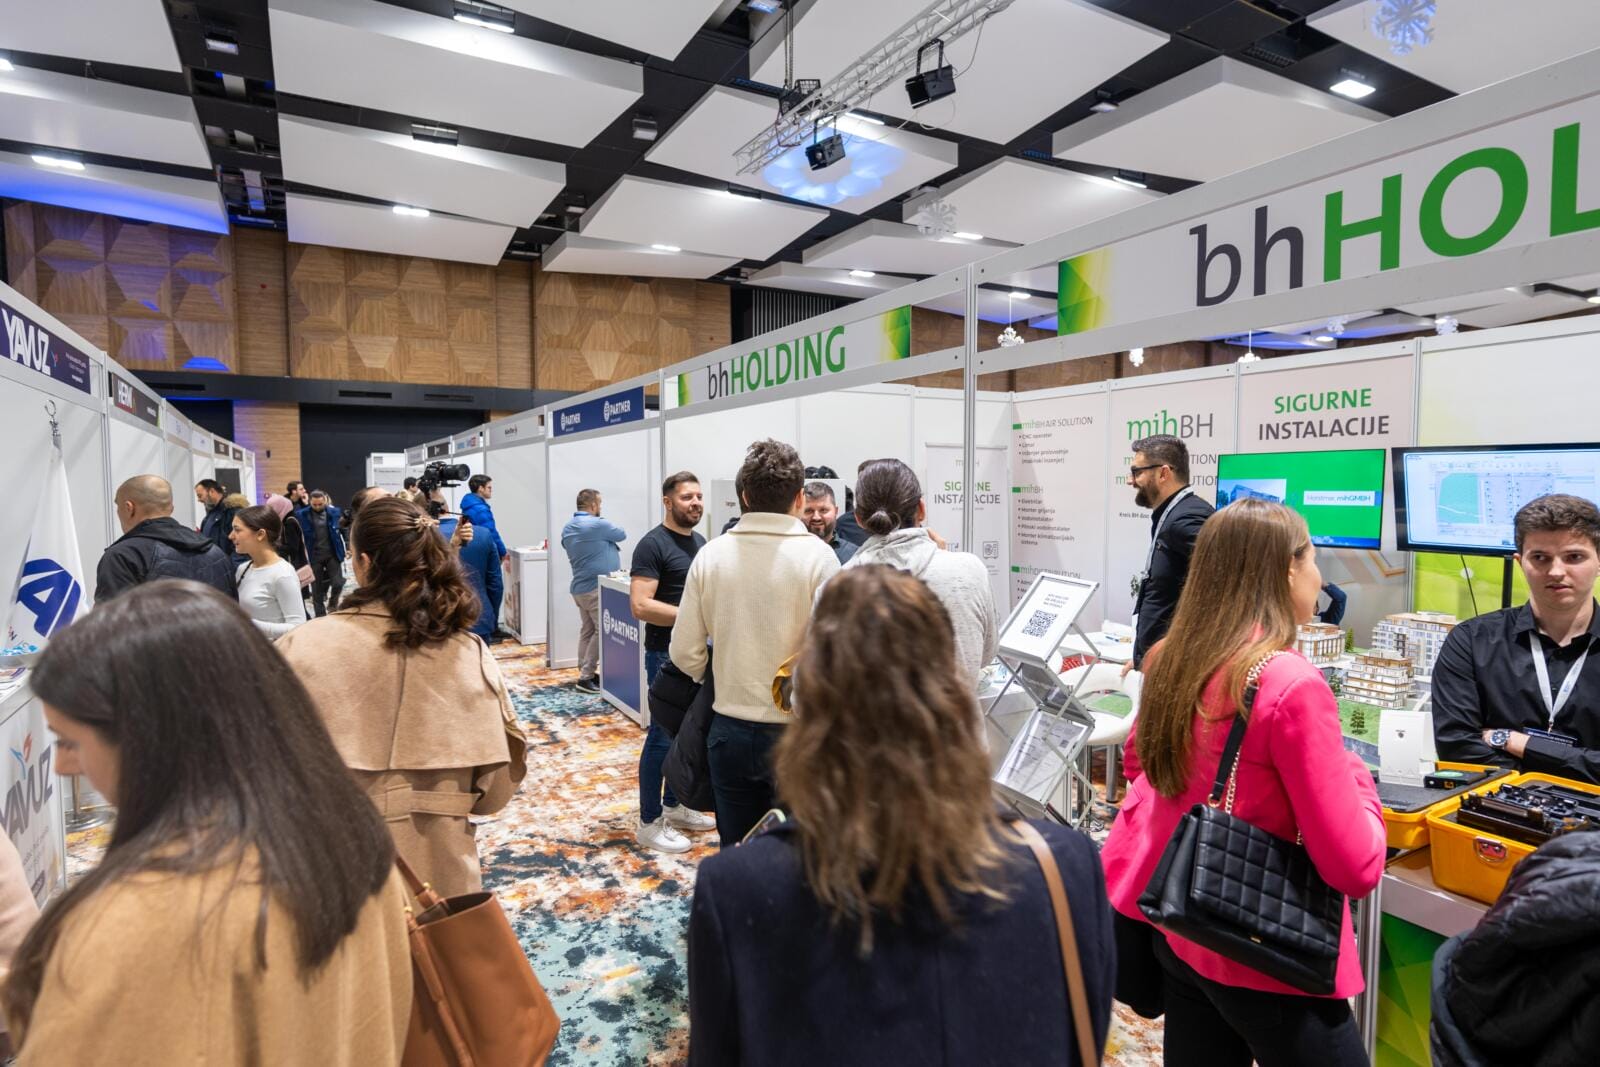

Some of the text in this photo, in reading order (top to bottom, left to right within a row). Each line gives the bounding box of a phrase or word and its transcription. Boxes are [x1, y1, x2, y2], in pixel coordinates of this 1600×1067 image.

[2, 308, 51, 376] YAVUZ
[707, 325, 845, 399] bhHOLDING
[609, 400, 631, 416] PARTNER
[1274, 388, 1372, 414] SIGURNE
[565, 412, 581, 425] PARTNER
[1057, 416, 1093, 427] SOLUTION
[1126, 410, 1213, 440] mihBH
[1259, 415, 1390, 440] INSTALACIJE
[944, 481, 991, 492] SIGNE
[934, 494, 1001, 505] INSTAACIJE
[610, 618, 639, 643] PARTNER
